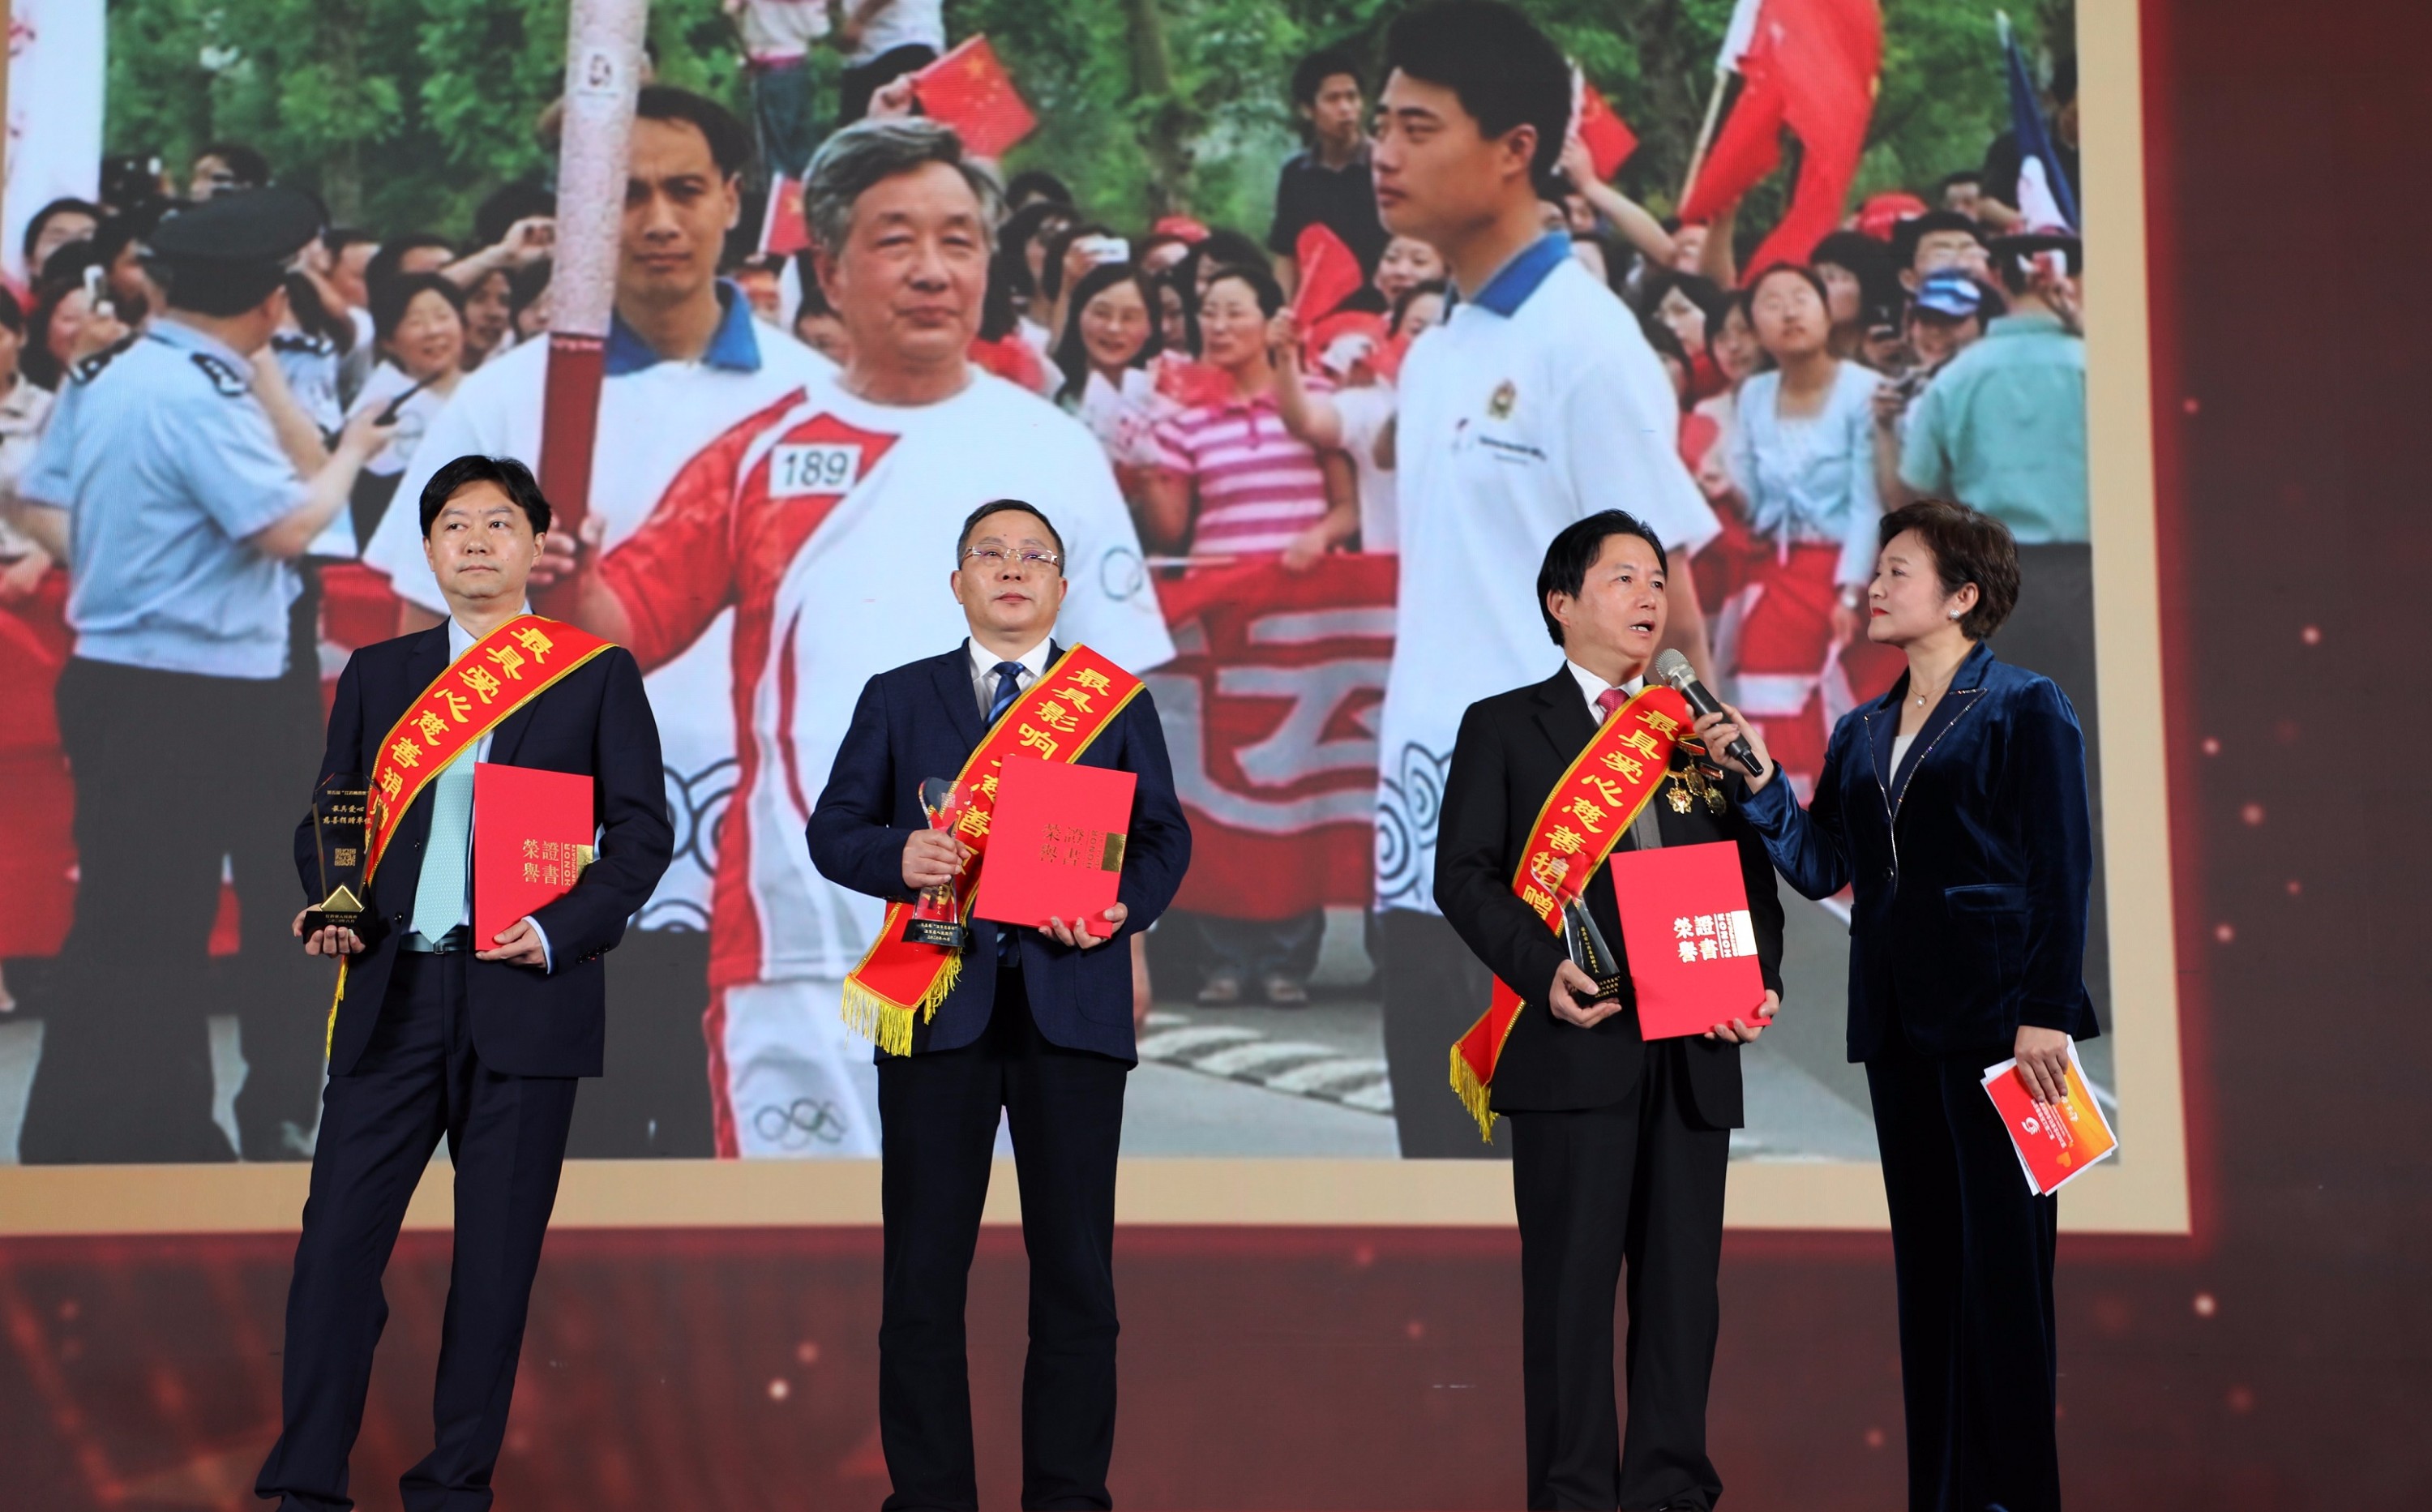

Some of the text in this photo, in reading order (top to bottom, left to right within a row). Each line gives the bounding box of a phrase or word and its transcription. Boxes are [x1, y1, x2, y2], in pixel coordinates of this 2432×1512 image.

[783, 451, 848, 486] 189
[563, 843, 572, 886] HONOR
[1717, 912, 1733, 958] HONOR
